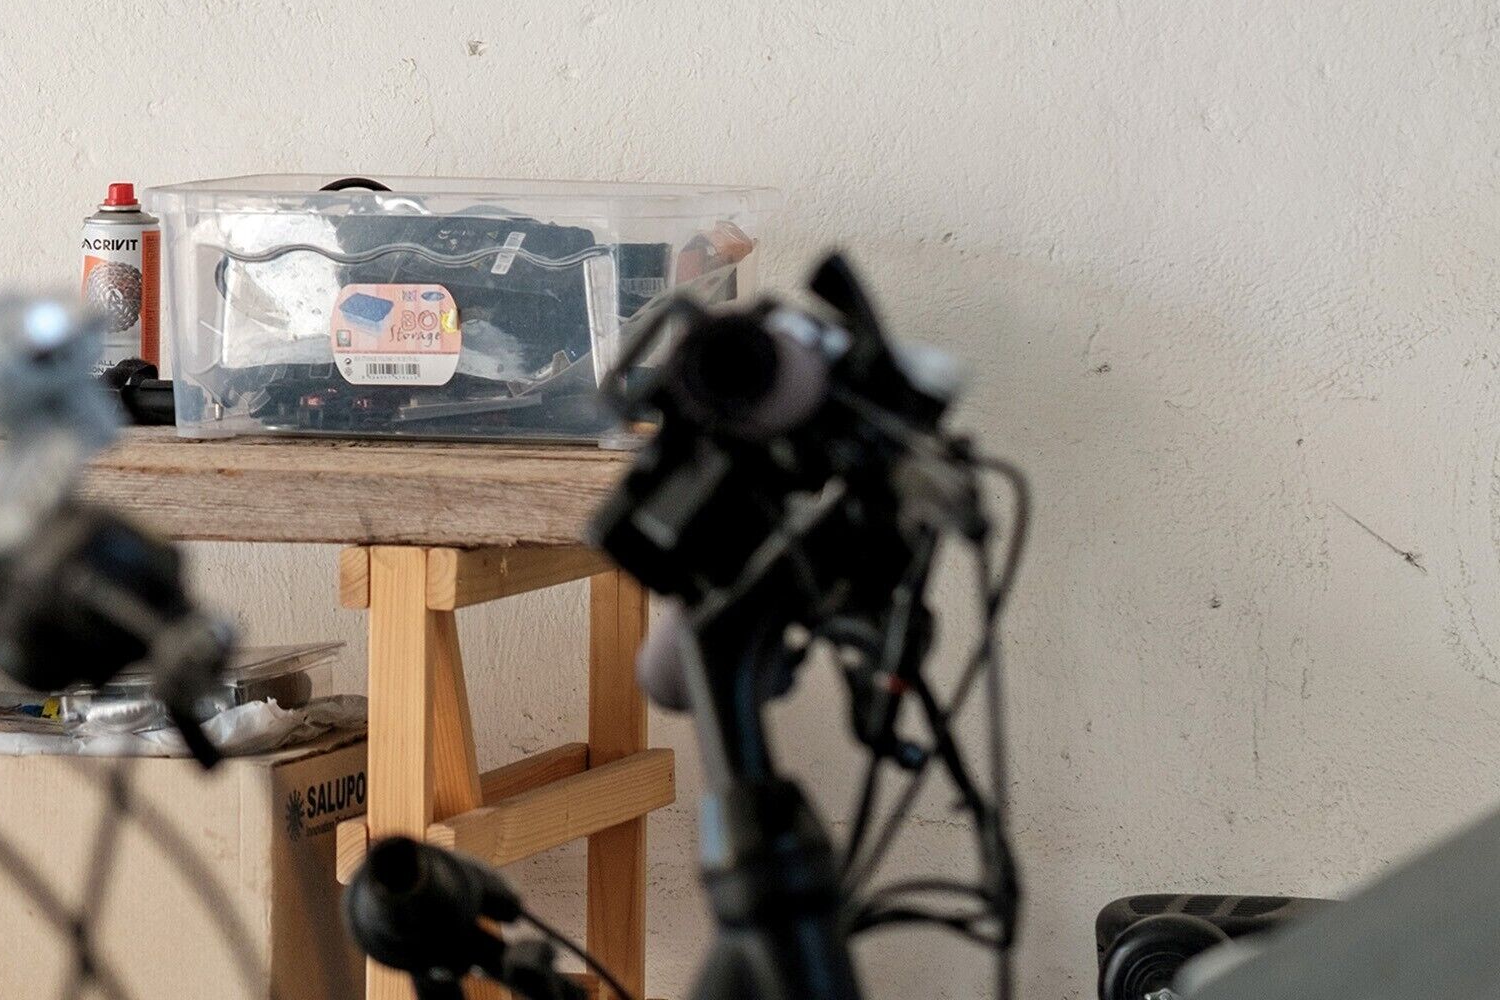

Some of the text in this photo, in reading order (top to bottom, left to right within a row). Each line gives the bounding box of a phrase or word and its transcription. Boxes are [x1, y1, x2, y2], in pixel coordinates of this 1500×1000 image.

[81, 238, 139, 251] ACRIVIT
[401, 309, 445, 331] BO
[389, 324, 442, 348] Storage
[307, 772, 365, 818] SALUPO
